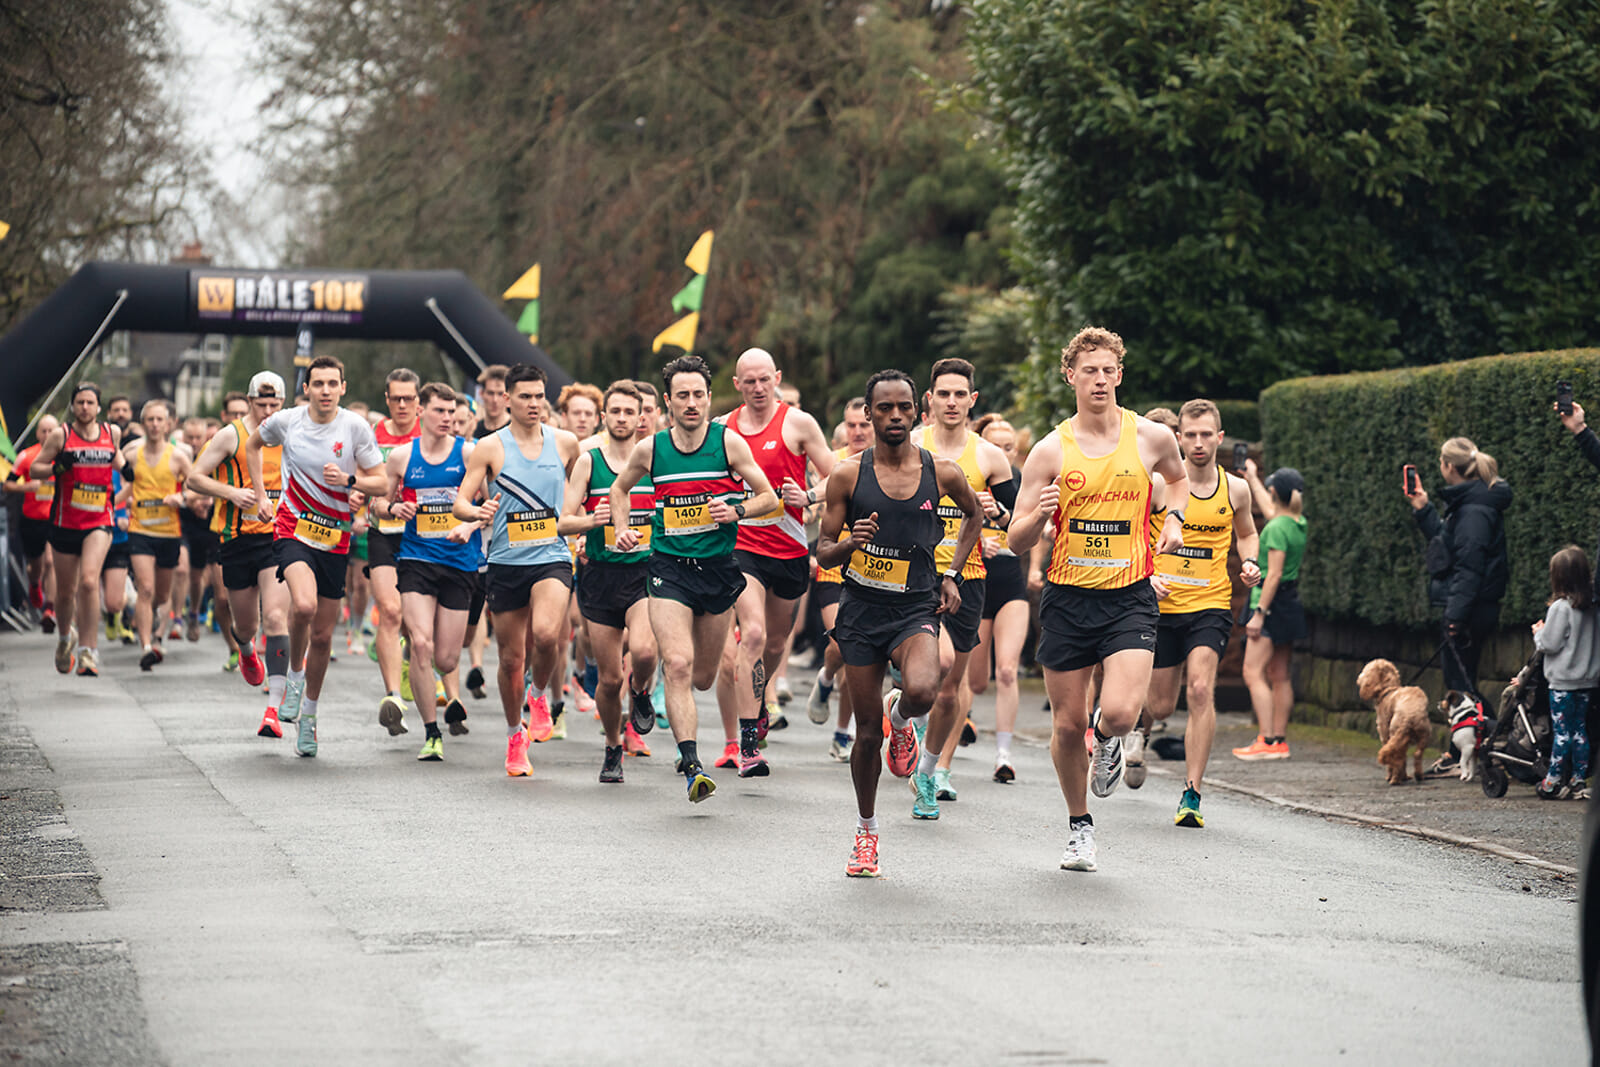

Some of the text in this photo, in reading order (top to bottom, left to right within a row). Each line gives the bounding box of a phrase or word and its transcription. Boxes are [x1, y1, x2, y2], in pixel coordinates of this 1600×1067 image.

[675, 507, 703, 519] 1407
[429, 515, 448, 525] 925
[307, 523, 332, 538] 1344
[520, 521, 546, 533] 1438
[1182, 523, 1226, 533] OCKPORT
[1085, 536, 1109, 548] 561
[1083, 548, 1113, 558] MICHAEL
[863, 554, 894, 572] 1500
[1183, 559, 1191, 569] 2
